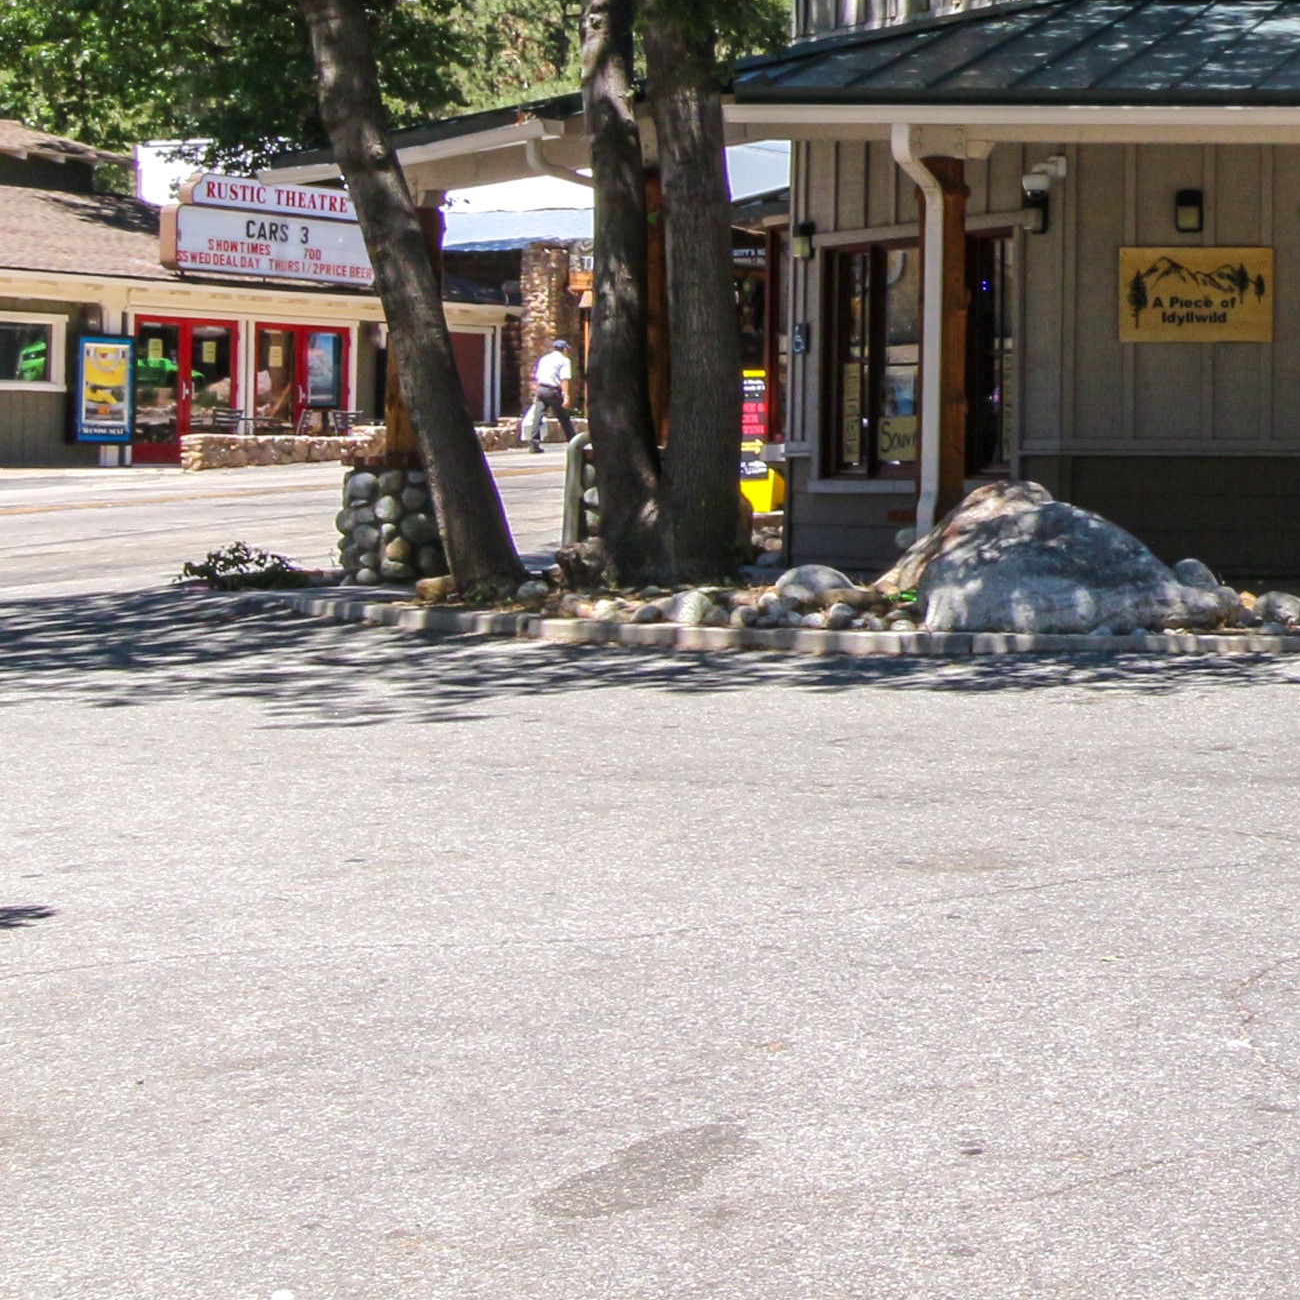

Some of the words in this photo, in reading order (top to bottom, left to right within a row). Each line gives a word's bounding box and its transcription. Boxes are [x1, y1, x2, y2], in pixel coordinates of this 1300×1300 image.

[206, 181, 266, 204] RUSTIC
[275, 188, 348, 213] THEATRE
[246, 220, 289, 242] CARS
[301, 226, 309, 244] 3
[208, 238, 271, 256] SHOWTIMES
[303, 248, 321, 260] 700
[269, 259, 300, 273] THURS
[1152, 296, 1164, 308] A
[1169, 296, 1214, 308] Piece
[1220, 296, 1237, 308] of
[1161, 311, 1227, 327] Idyllwild
